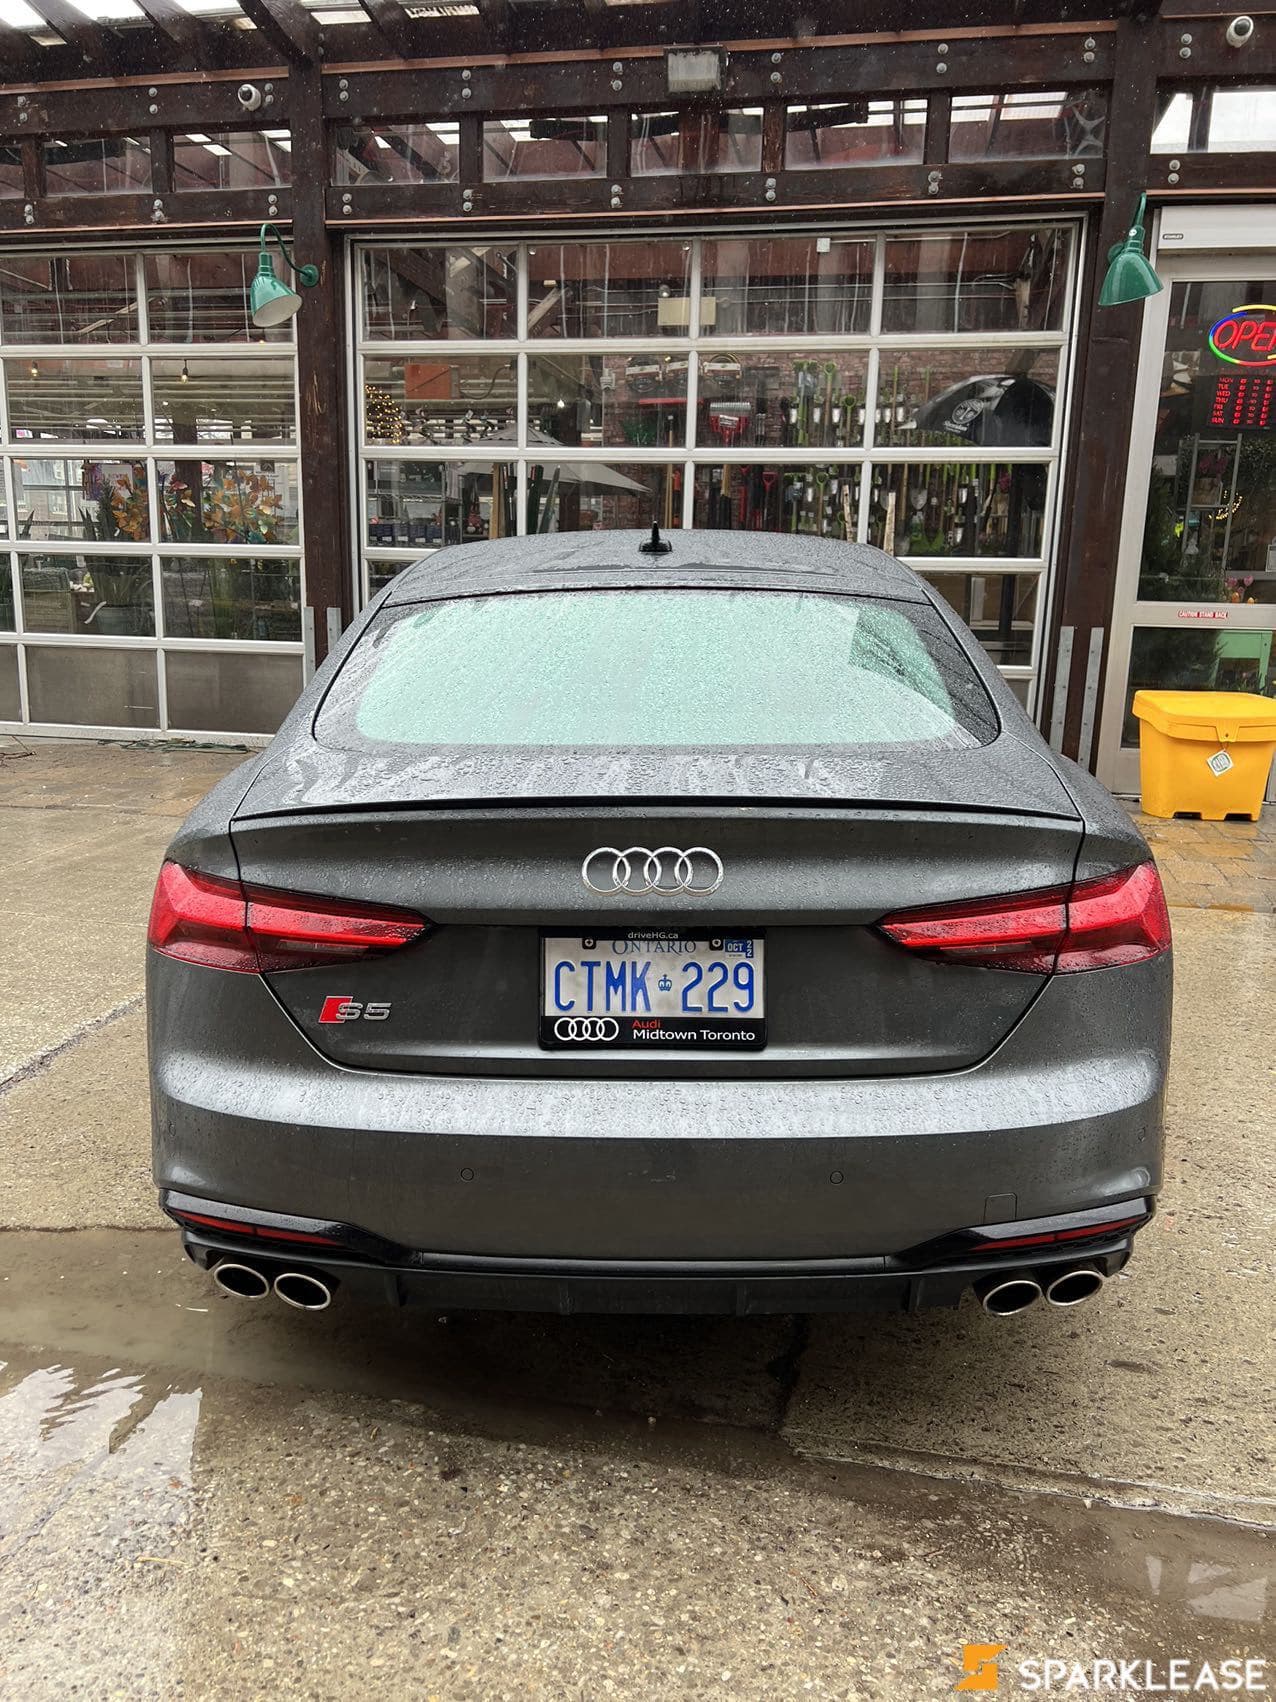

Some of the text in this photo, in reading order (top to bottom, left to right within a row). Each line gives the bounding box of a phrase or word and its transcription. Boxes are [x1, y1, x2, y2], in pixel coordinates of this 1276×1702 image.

[627, 931, 679, 940] driveHG.ca
[612, 940, 697, 956] ONTARIO
[727, 943, 744, 952] OCT
[554, 960, 755, 1013] CTMK 229
[336, 1002, 392, 1020] S5
[632, 1019, 661, 1030] Audi
[633, 1029, 756, 1041] Midtown Toronto
